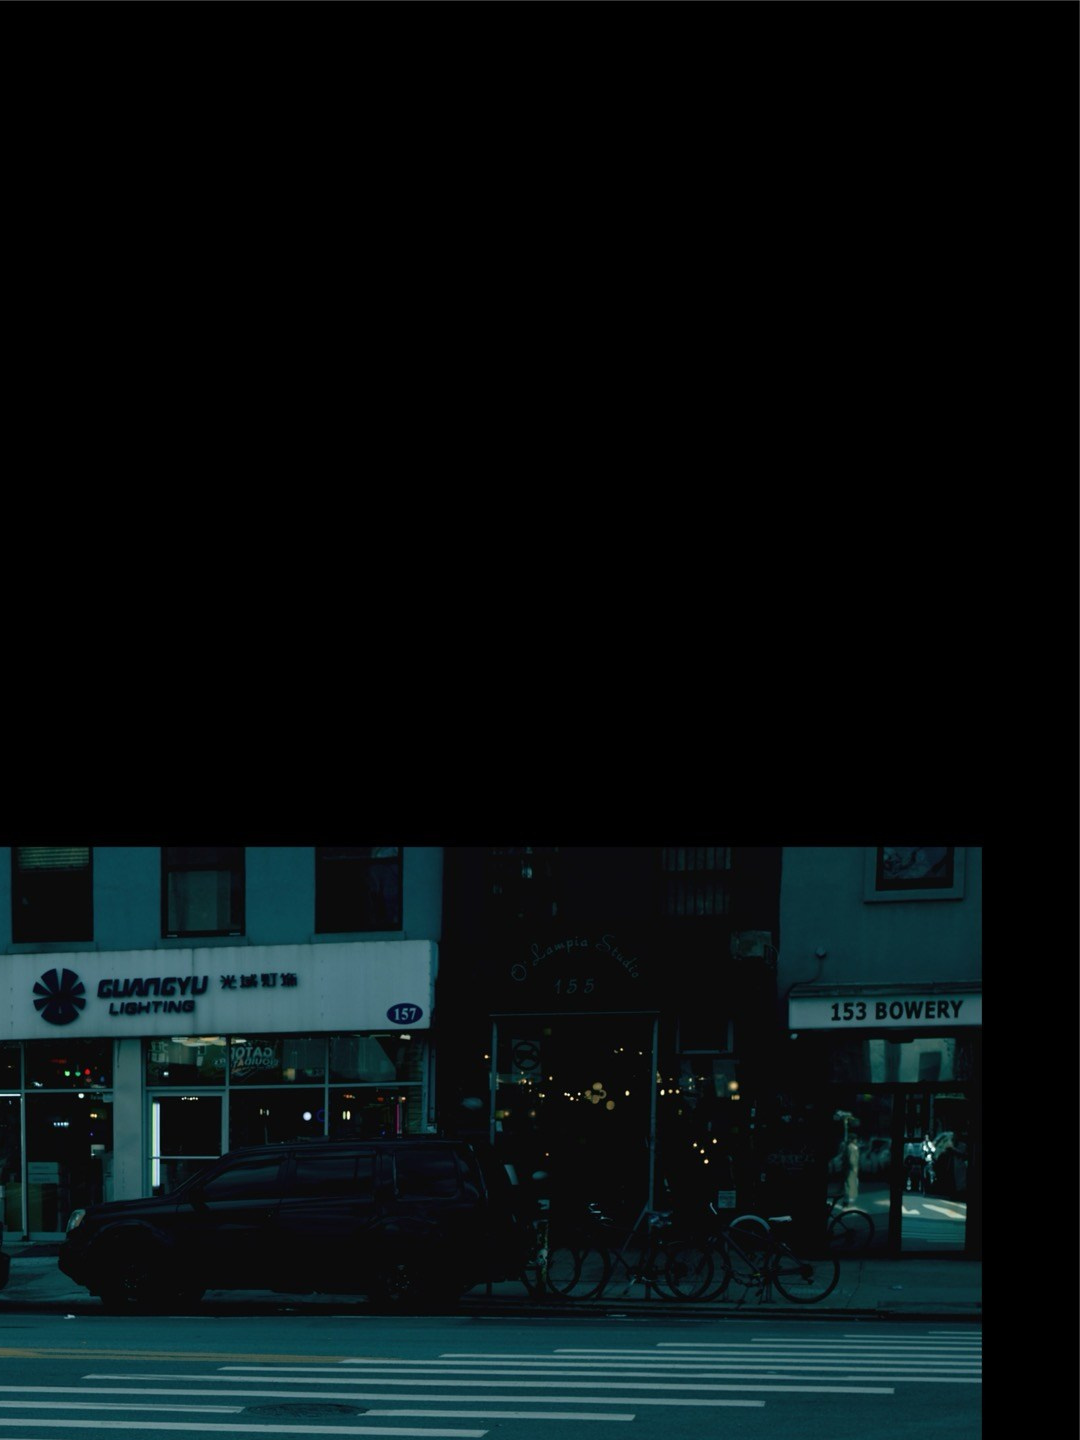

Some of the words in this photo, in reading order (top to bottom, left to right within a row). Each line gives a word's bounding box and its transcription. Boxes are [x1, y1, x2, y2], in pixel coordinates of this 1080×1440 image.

[595, 934, 639, 978] Studio
[97, 976, 208, 998] GUANGYU
[554, 978, 595, 994] 155
[109, 1000, 195, 1016] LIGHTING
[394, 1007, 417, 1021] 157
[831, 1001, 867, 1021] 153
[875, 1000, 964, 1020] BOWERY
